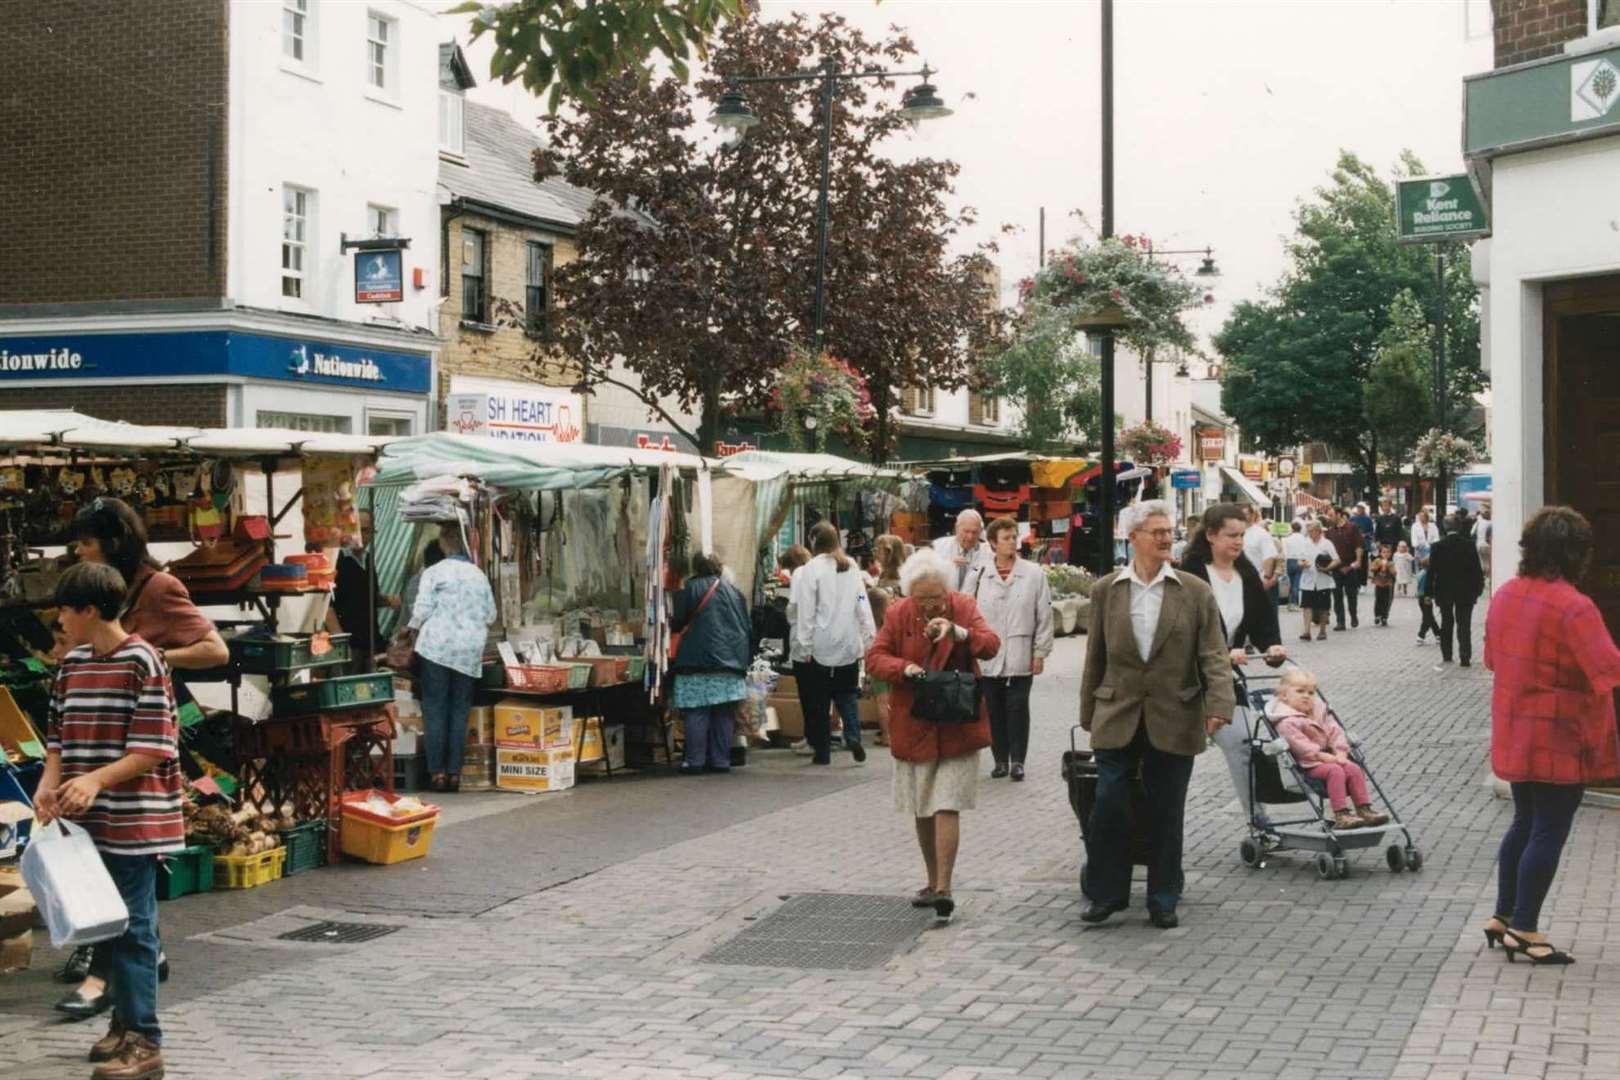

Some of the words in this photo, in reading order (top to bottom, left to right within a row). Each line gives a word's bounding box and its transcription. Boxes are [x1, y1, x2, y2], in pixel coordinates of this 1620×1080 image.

[1426, 198, 1459, 212] Kent
[1413, 210, 1472, 225] Reliance
[313, 352, 381, 380] Nationwide
[488, 396, 506, 420] SH
[512, 400, 553, 424] HEART
[501, 764, 523, 774] MINI
[525, 766, 548, 776] SIZE
